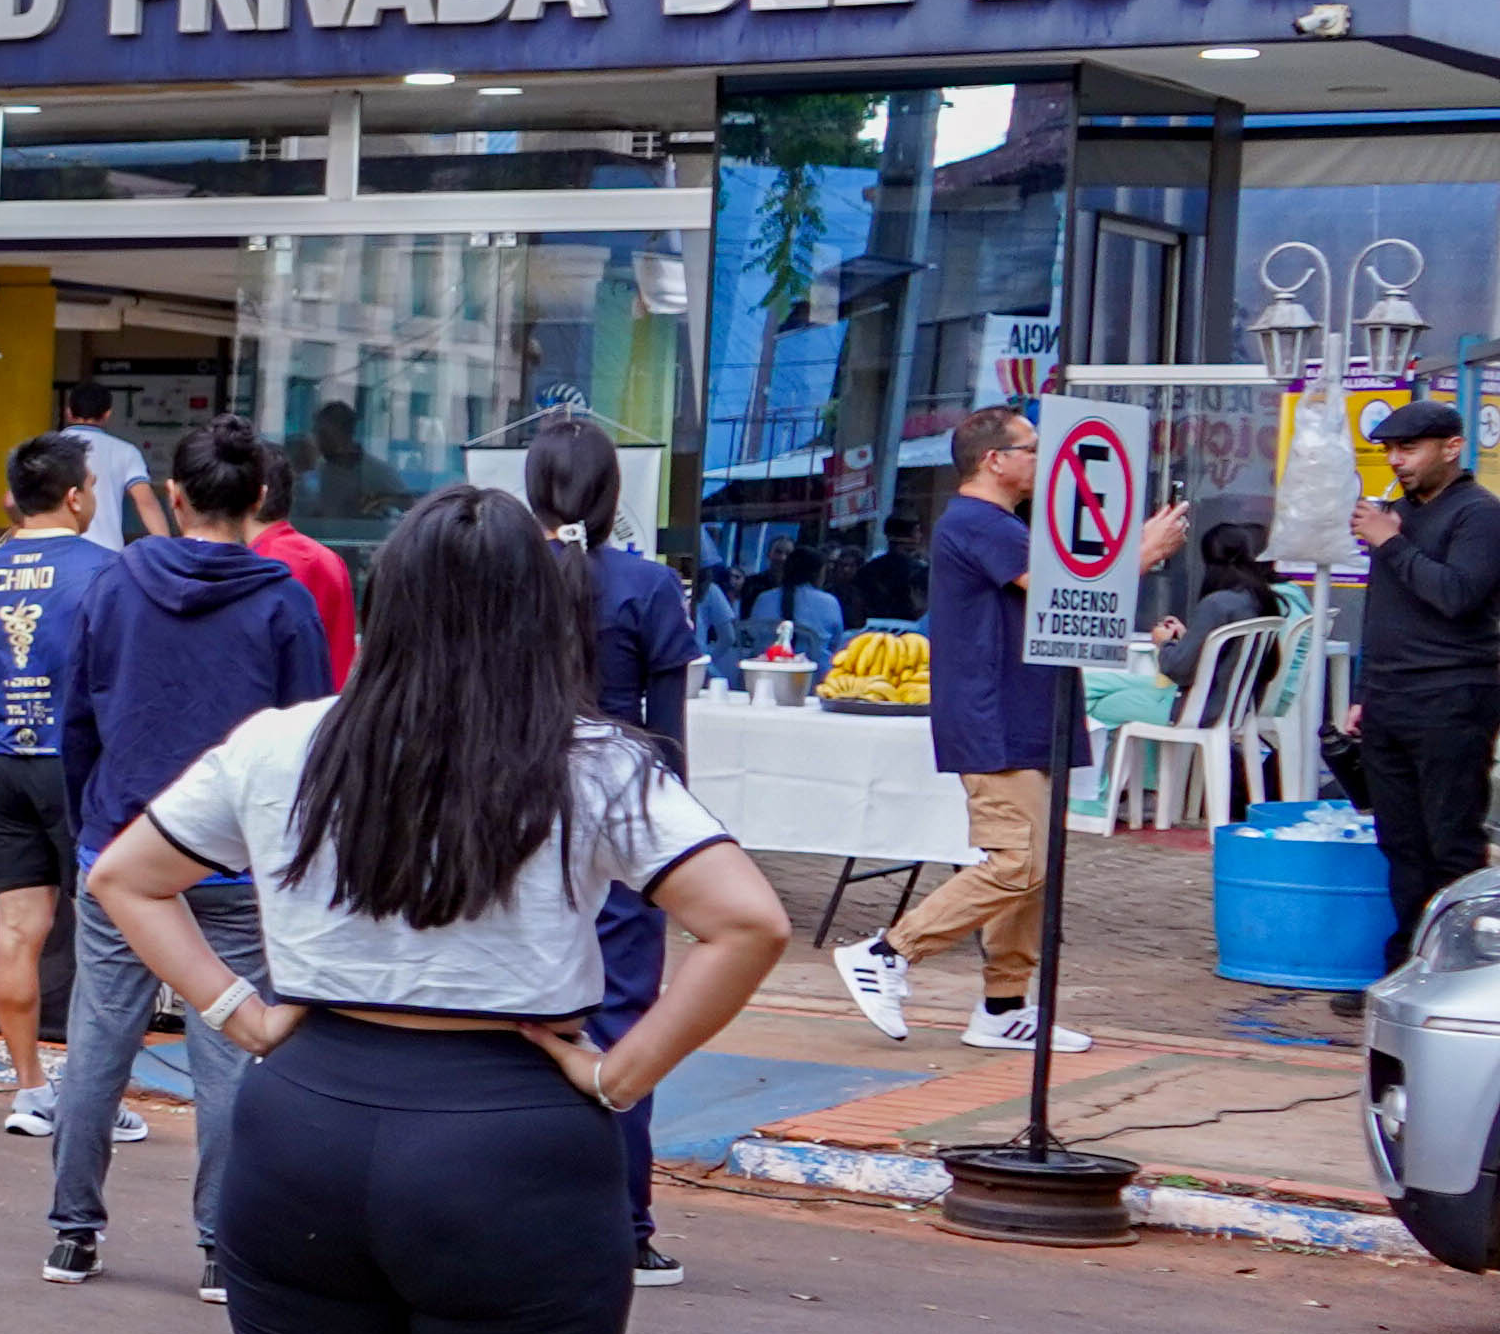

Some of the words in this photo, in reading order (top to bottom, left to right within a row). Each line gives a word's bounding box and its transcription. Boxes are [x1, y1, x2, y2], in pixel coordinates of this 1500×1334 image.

[1050, 588, 1118, 613] ASCENSO
[1037, 612, 1046, 633] Y
[1052, 613, 1126, 639] DESCENSO
